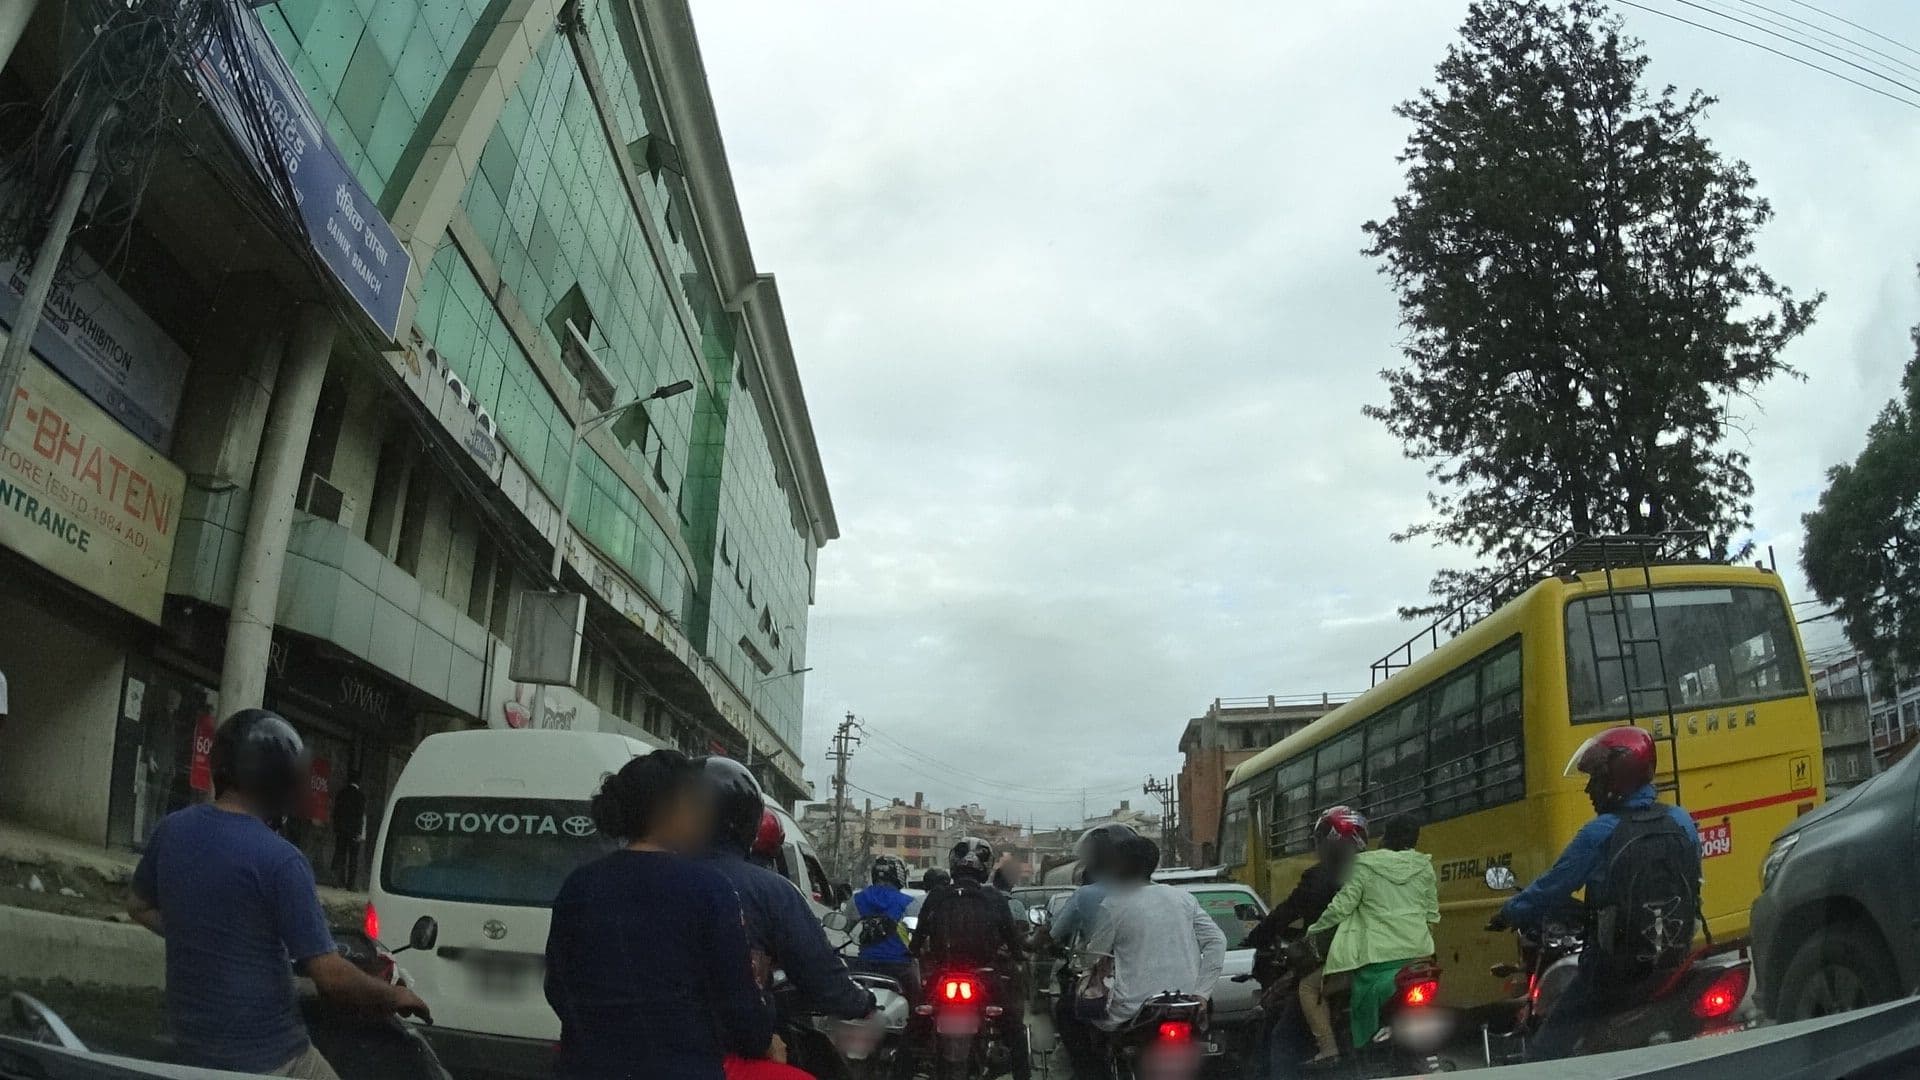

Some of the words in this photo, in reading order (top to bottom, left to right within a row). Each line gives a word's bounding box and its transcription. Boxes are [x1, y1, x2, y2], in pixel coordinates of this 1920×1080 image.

[326, 216, 351, 258] SAINIK
[351, 251, 382, 295] BRANCH
[444, 812, 558, 835] TOYOTA
